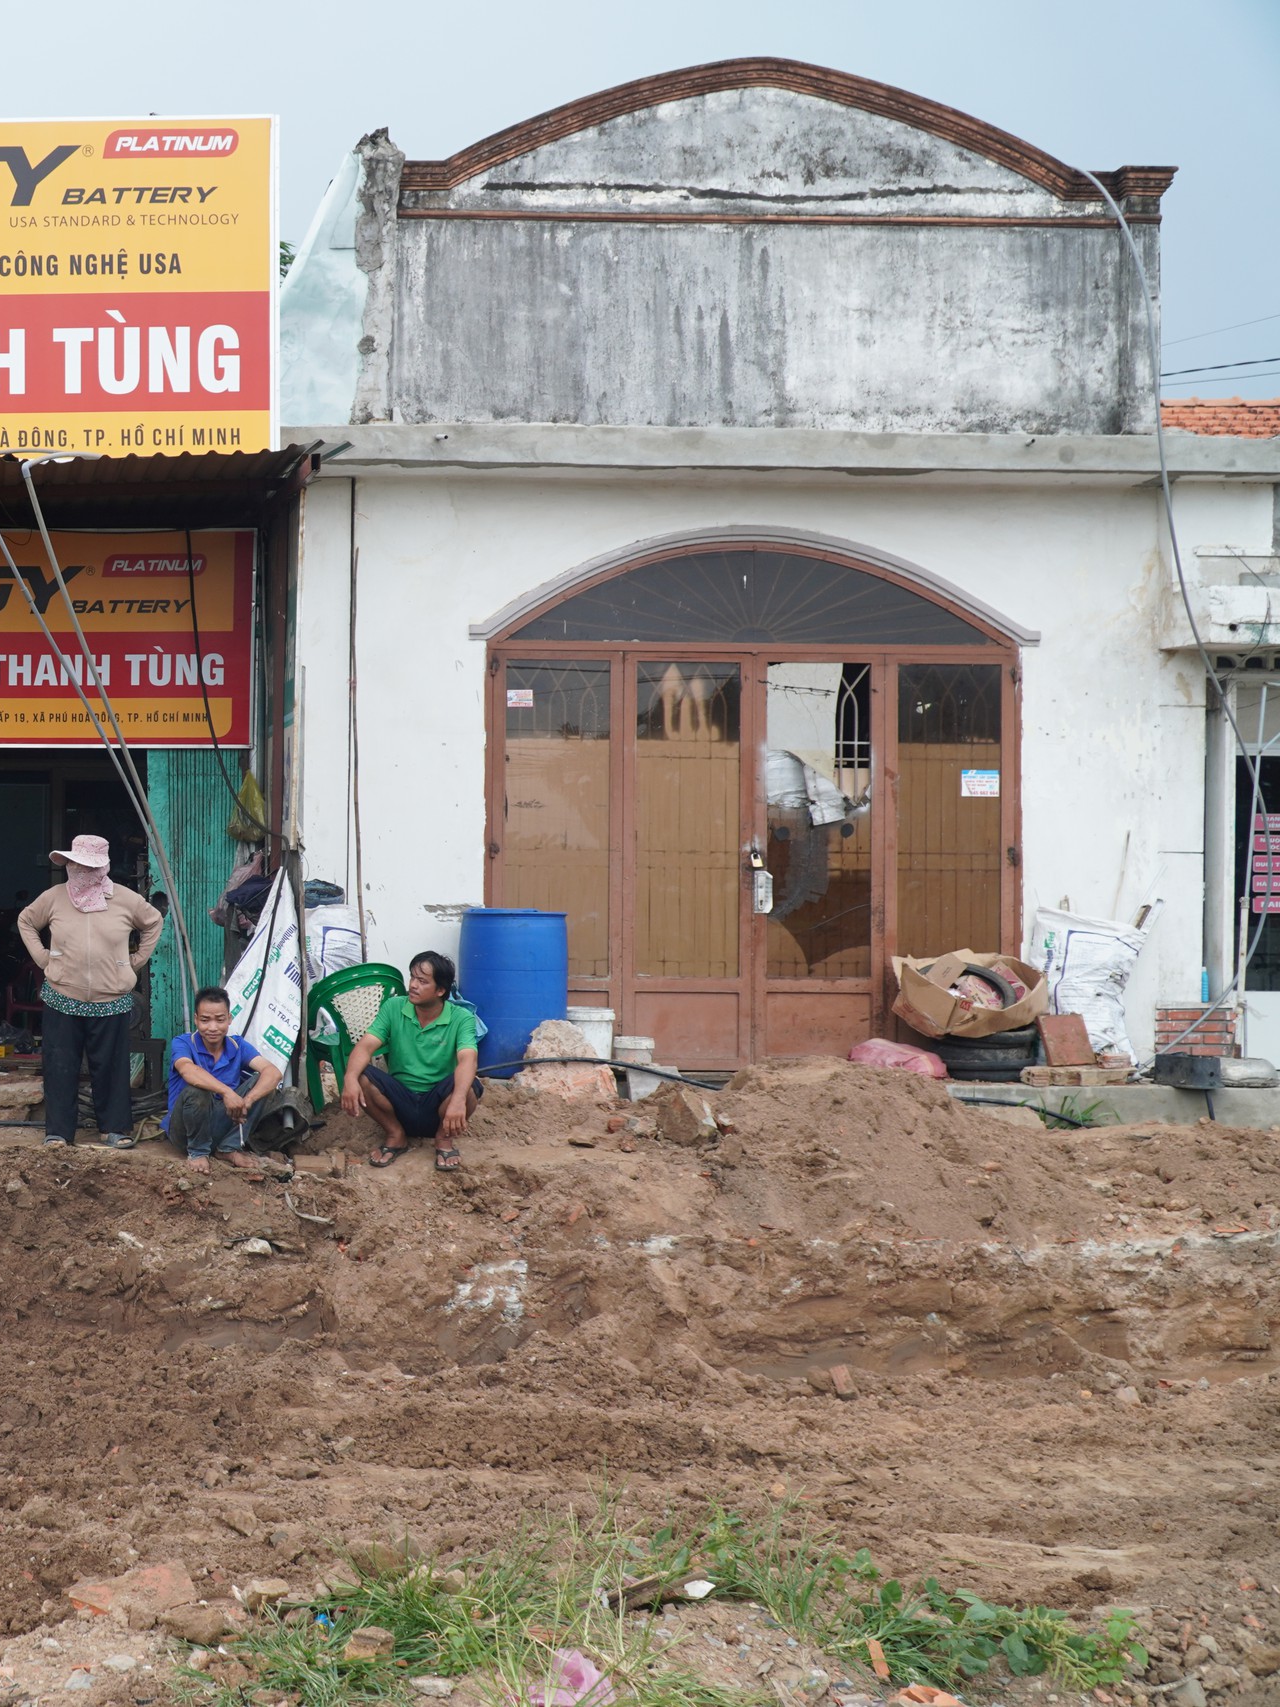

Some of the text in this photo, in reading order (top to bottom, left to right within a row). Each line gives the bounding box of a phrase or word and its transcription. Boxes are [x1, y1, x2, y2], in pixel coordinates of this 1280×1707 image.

[115, 135, 234, 152] PLATINUM
[61, 186, 218, 205] BATTERY
[10, 213, 239, 228] USA STANDARD & TECHNOLOGY
[69, 248, 129, 279] NGHỆ
[139, 252, 183, 275] USA
[52, 309, 241, 396] TÙNG
[18, 426, 74, 449] ĐÔNG,
[83, 428, 112, 446] TP.
[121, 423, 145, 446] HỒ
[152, 424, 184, 446] CHÍ
[192, 427, 241, 446] MINH
[112, 559, 203, 572] PLATINUM
[72, 599, 192, 614] BATTERY
[124, 645, 225, 687] TÙNG
[14, 713, 29, 724] 19,
[33, 711, 46, 723] XÃ
[49, 711, 68, 723] PHÚ
[127, 712, 143, 723] TP.
[162, 710, 179, 723] CHÍ
[182, 712, 208, 723] MINH
